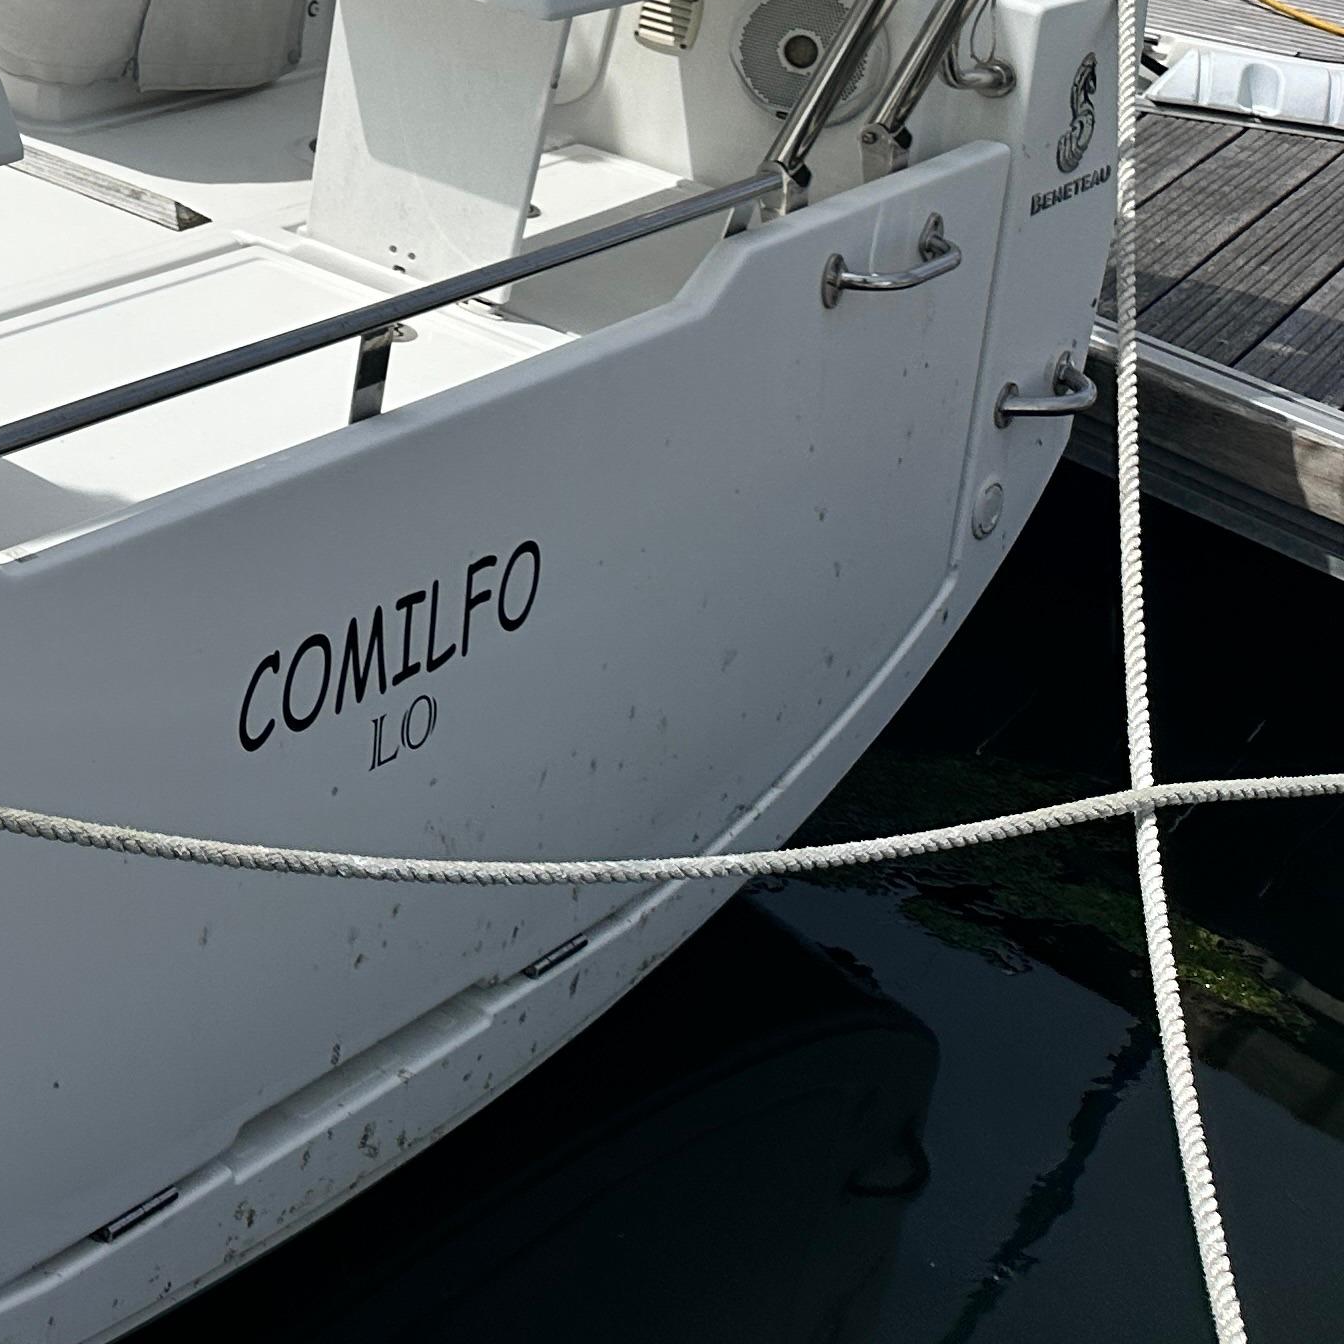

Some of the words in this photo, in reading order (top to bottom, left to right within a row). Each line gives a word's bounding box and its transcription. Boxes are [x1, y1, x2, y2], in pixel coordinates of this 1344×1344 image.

[1030, 164, 1112, 217] BENETEAU
[238, 539, 541, 753] COMILFO
[368, 694, 438, 772] LO
